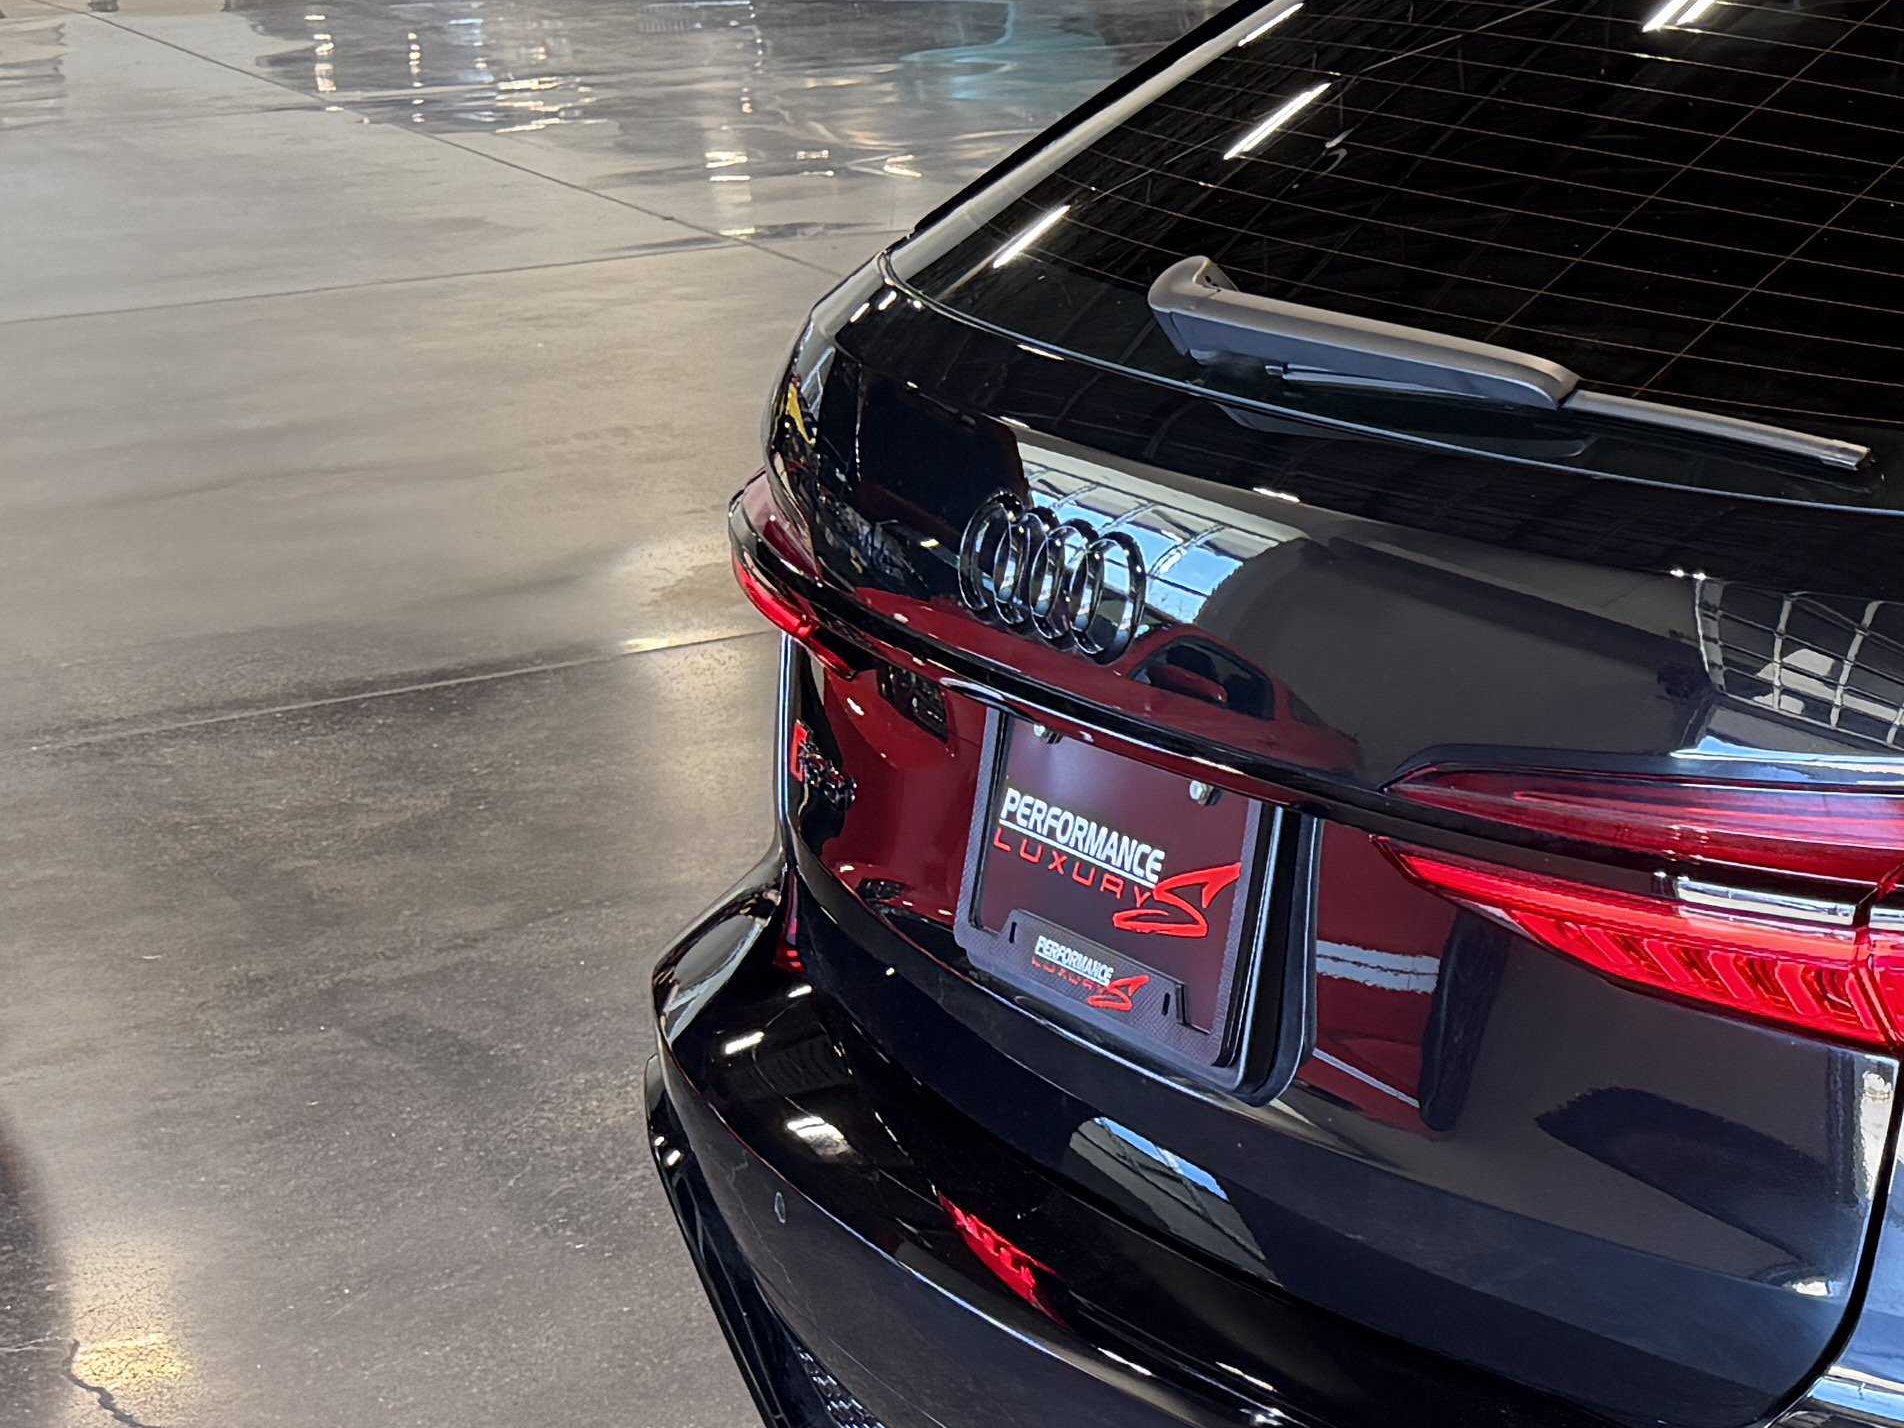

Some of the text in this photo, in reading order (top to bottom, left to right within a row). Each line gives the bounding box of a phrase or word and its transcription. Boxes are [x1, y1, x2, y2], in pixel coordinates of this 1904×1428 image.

[993, 827, 1152, 908] LUXURY
[1000, 787, 1166, 884] PERFORMANCE
[1034, 935, 1115, 981] PERFORMANCE
